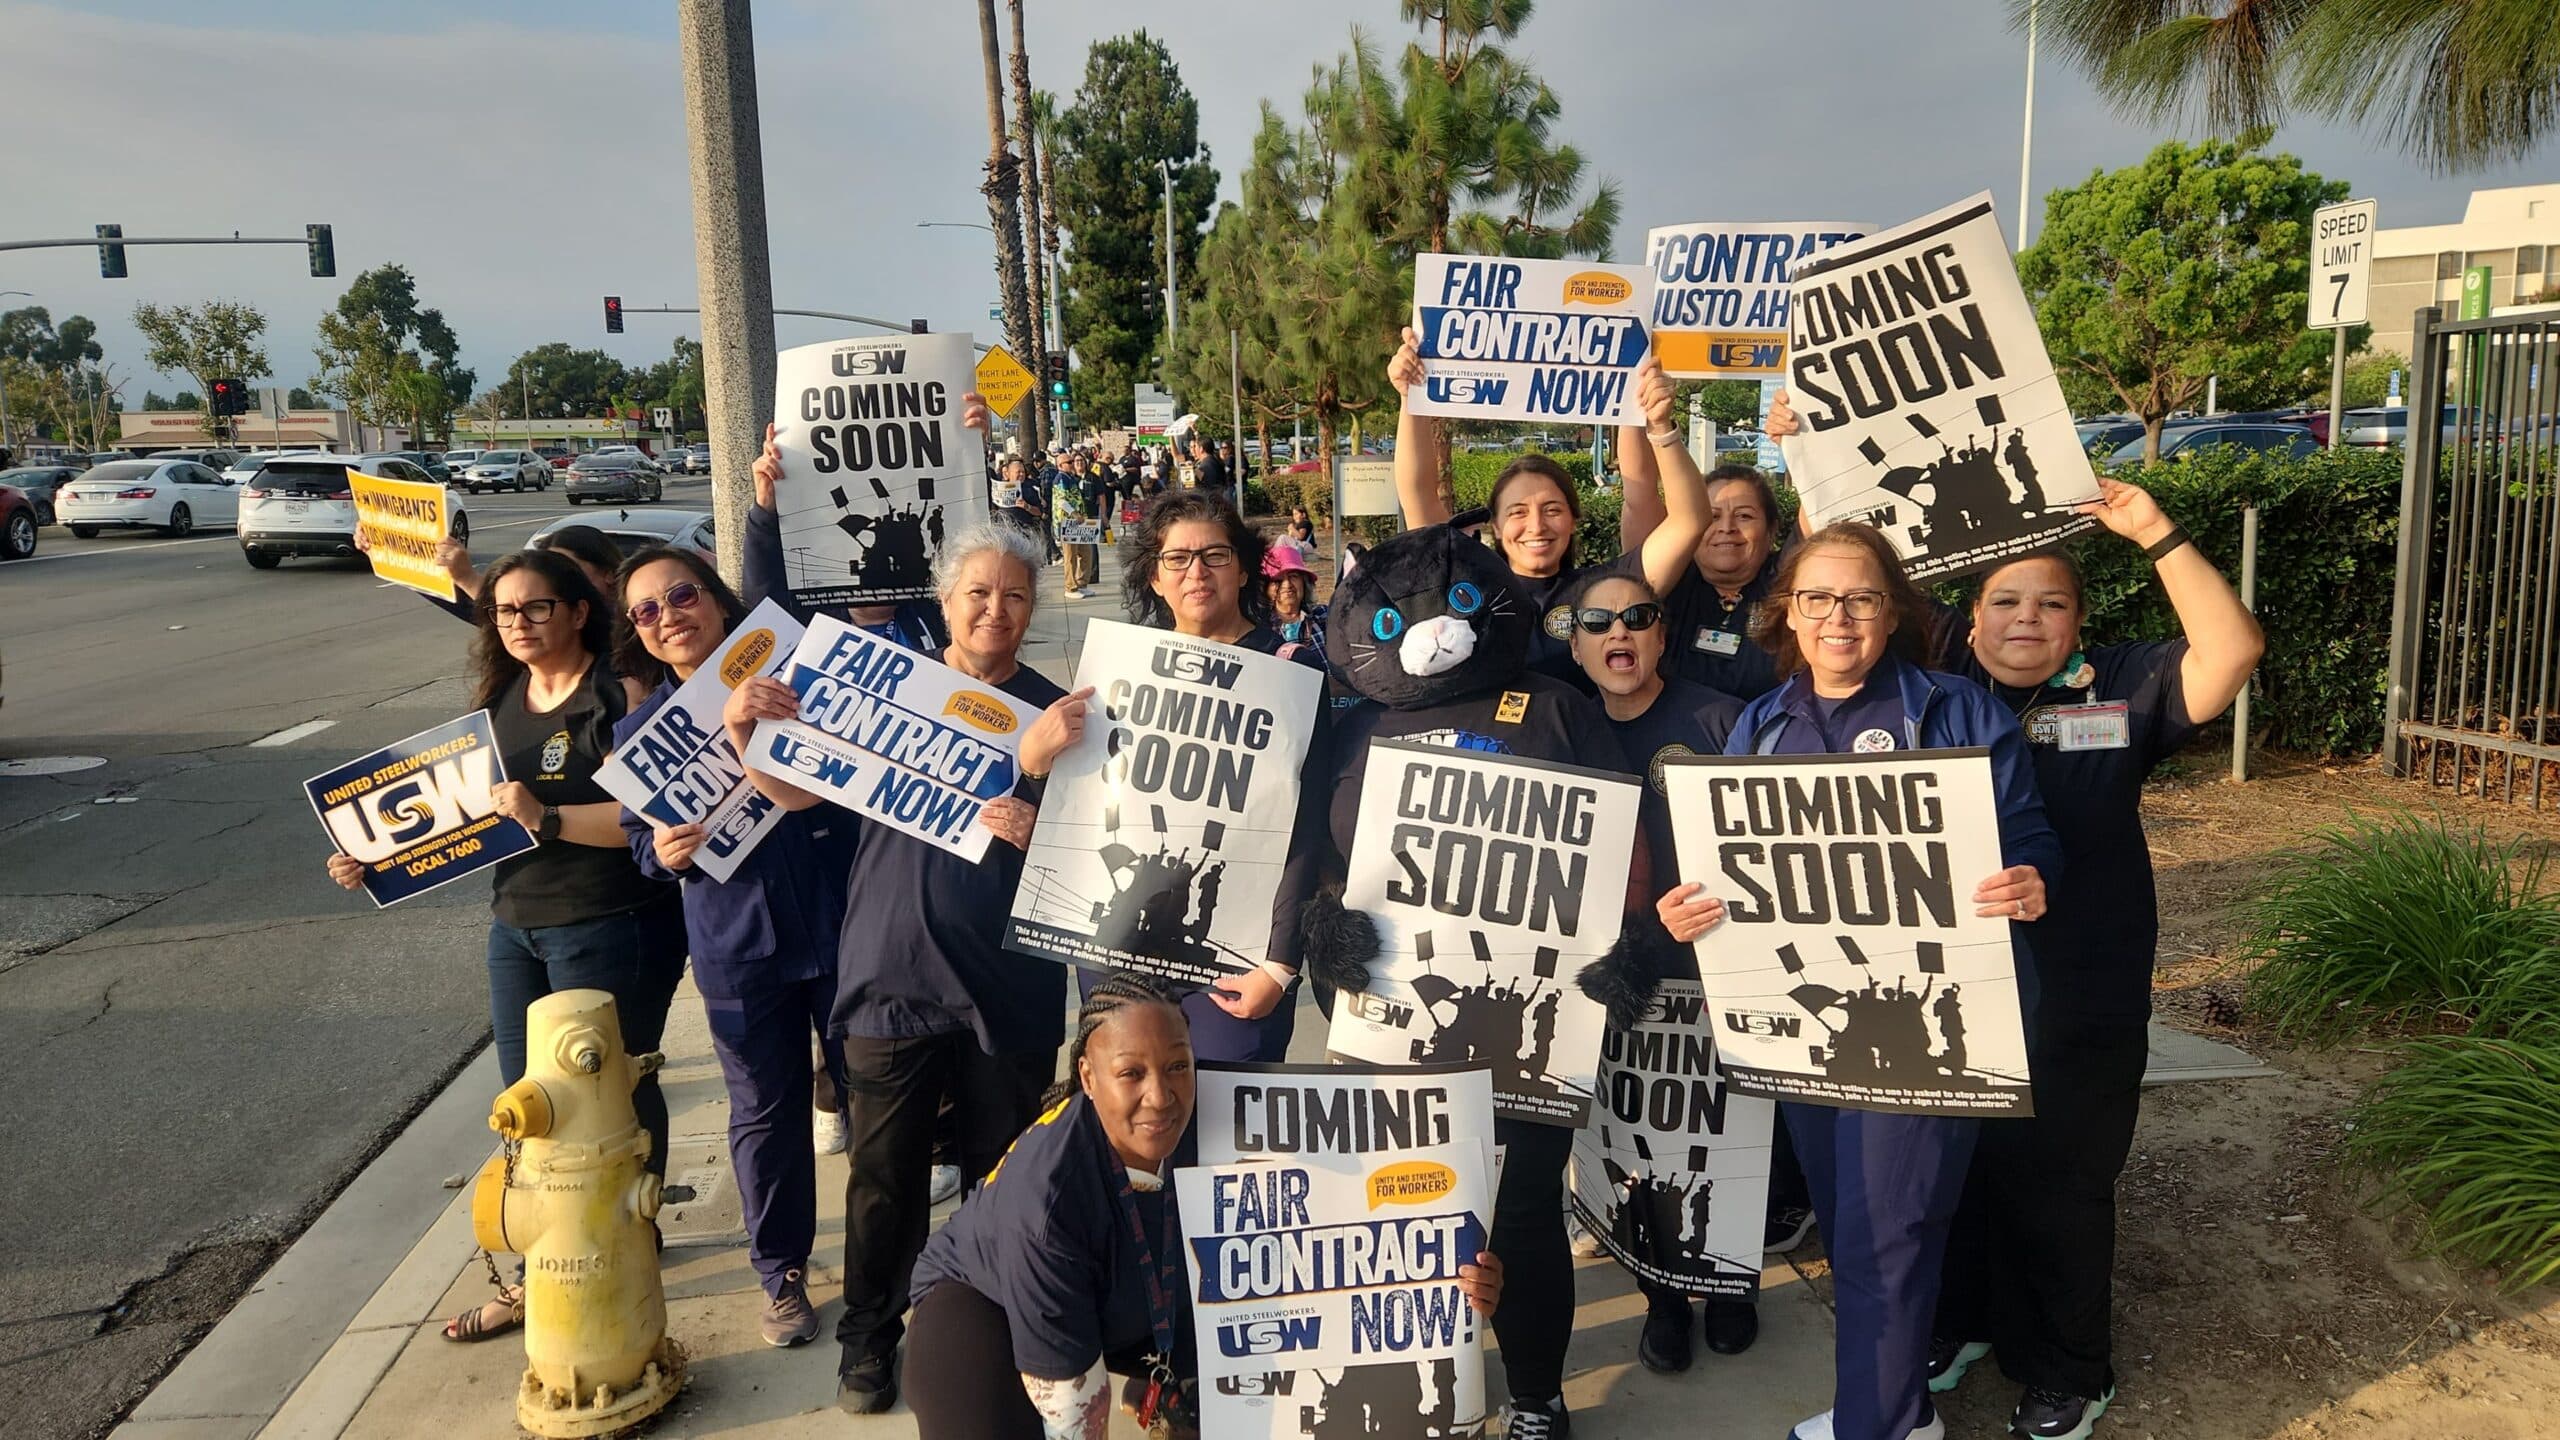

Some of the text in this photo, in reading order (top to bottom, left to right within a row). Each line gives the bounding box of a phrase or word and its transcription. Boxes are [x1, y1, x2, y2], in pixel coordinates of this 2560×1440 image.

[2320, 212, 2367, 240] SPEED
[1651, 233, 1866, 284] ¡CONTRA
[2323, 242, 2361, 267] LIMIT
[1441, 261, 1522, 309] FAIR
[1570, 287, 1625, 298] FOR WORKERS
[1600, 281, 1625, 289] STRENGTH
[1791, 243, 1971, 352] COMING
[2330, 273, 2350, 318] 7
[2469, 275, 2478, 289] 7
[834, 343, 903, 352] UNITED STEELWORKERS
[1437, 310, 1633, 365] CONTRACT
[1709, 344, 1784, 368] USW
[832, 350, 906, 377] USW
[978, 369, 1020, 378] RIGHT LANE
[1457, 370, 1505, 378] STEELWORKERS
[1792, 303, 2006, 432] SOON
[801, 381, 946, 422] COMING
[977, 381, 1023, 390] TURNS RIGHT
[990, 393, 1012, 401] AHEAD
[1427, 376, 1508, 405] USW
[1526, 368, 1627, 417] NOW!
[810, 420, 944, 473] SOON
[370, 491, 437, 522] IMMIGRANTS
[729, 636, 773, 683] FOR WORKERS
[818, 630, 914, 699] FAIR
[1151, 646, 1243, 691] USW
[1160, 639, 1241, 662] UNITED STEELWORKERS
[953, 700, 1010, 731] FOR WORKERS
[959, 695, 1012, 722] UNITY AND STRENGTH
[1106, 679, 1273, 751] COMING
[620, 705, 709, 793] FAIR
[782, 727, 857, 765] UNITED STEELWORKERS
[798, 677, 1005, 794] CONTRACT
[323, 733, 477, 805] UNITED STEELWORKERS
[664, 737, 747, 824] CON
[769, 733, 858, 789] USW
[1101, 727, 1255, 813] SOON
[324, 745, 497, 863] USW
[721, 784, 757, 822] STEELWORKER
[866, 766, 981, 845] NOW!
[1397, 762, 1598, 846] COMING
[1709, 772, 1944, 836] COMING
[374, 816, 499, 872] UNITY AND STRENGTH FOR WORKERS
[705, 789, 777, 859] USW
[406, 838, 482, 877] LOCAL 7600
[1386, 823, 1588, 938] SOON
[1718, 841, 1957, 928] SOON
[1348, 993, 1414, 1029] USW
[1641, 993, 1704, 1026] SW
[1725, 1013, 1801, 1038] USW
[1750, 1008, 1797, 1017] STEELWORKERS
[1603, 1027, 1723, 1077] OMIN
[1493, 1091, 1580, 1112] asked to stop working,
[1595, 1063, 1727, 1135] SOON
[1732, 1071, 1749, 1081] This
[1760, 1075, 1773, 1084] not
[1782, 1077, 1808, 1088] strike.
[1809, 1080, 1820, 1089] By
[1822, 1082, 1839, 1090] this
[1841, 1083, 1870, 1095] action,
[1885, 1089, 1902, 1097] one
[1903, 1089, 1912, 1097] is
[1914, 1089, 1942, 1098] asked
[1955, 1091, 1976, 1101] stop
[1977, 1092, 2019, 1102] working,
[1740, 1081, 1766, 1091] refuse
[1767, 1083, 1776, 1091] to
[1777, 1085, 1799, 1094] make
[1801, 1087, 1844, 1100] deliveries,
[1845, 1092, 1862, 1101] join
[1871, 1095, 1900, 1105] union,
[1912, 1098, 1932, 1107] sign
[1942, 1099, 1969, 1107] union
[1970, 1100, 2013, 1109] contract.
[1234, 1084, 1450, 1154] COMING
[1514, 1103, 1573, 1118] union contract.
[1375, 1170, 1446, 1185] UNITY AND STRENGTH
[1376, 1179, 1448, 1197] FOR WORKERS
[1213, 1168, 1312, 1234] FAIR
[536, 1255, 606, 1272] JONES
[1218, 1216, 1466, 1301] CONTRACT
[1219, 1307, 1316, 1324] UNITED STEELWORKERS
[1351, 1288, 1473, 1355] NOW!
[1216, 1315, 1323, 1358] USW
[1216, 1370, 1296, 1396] USW
